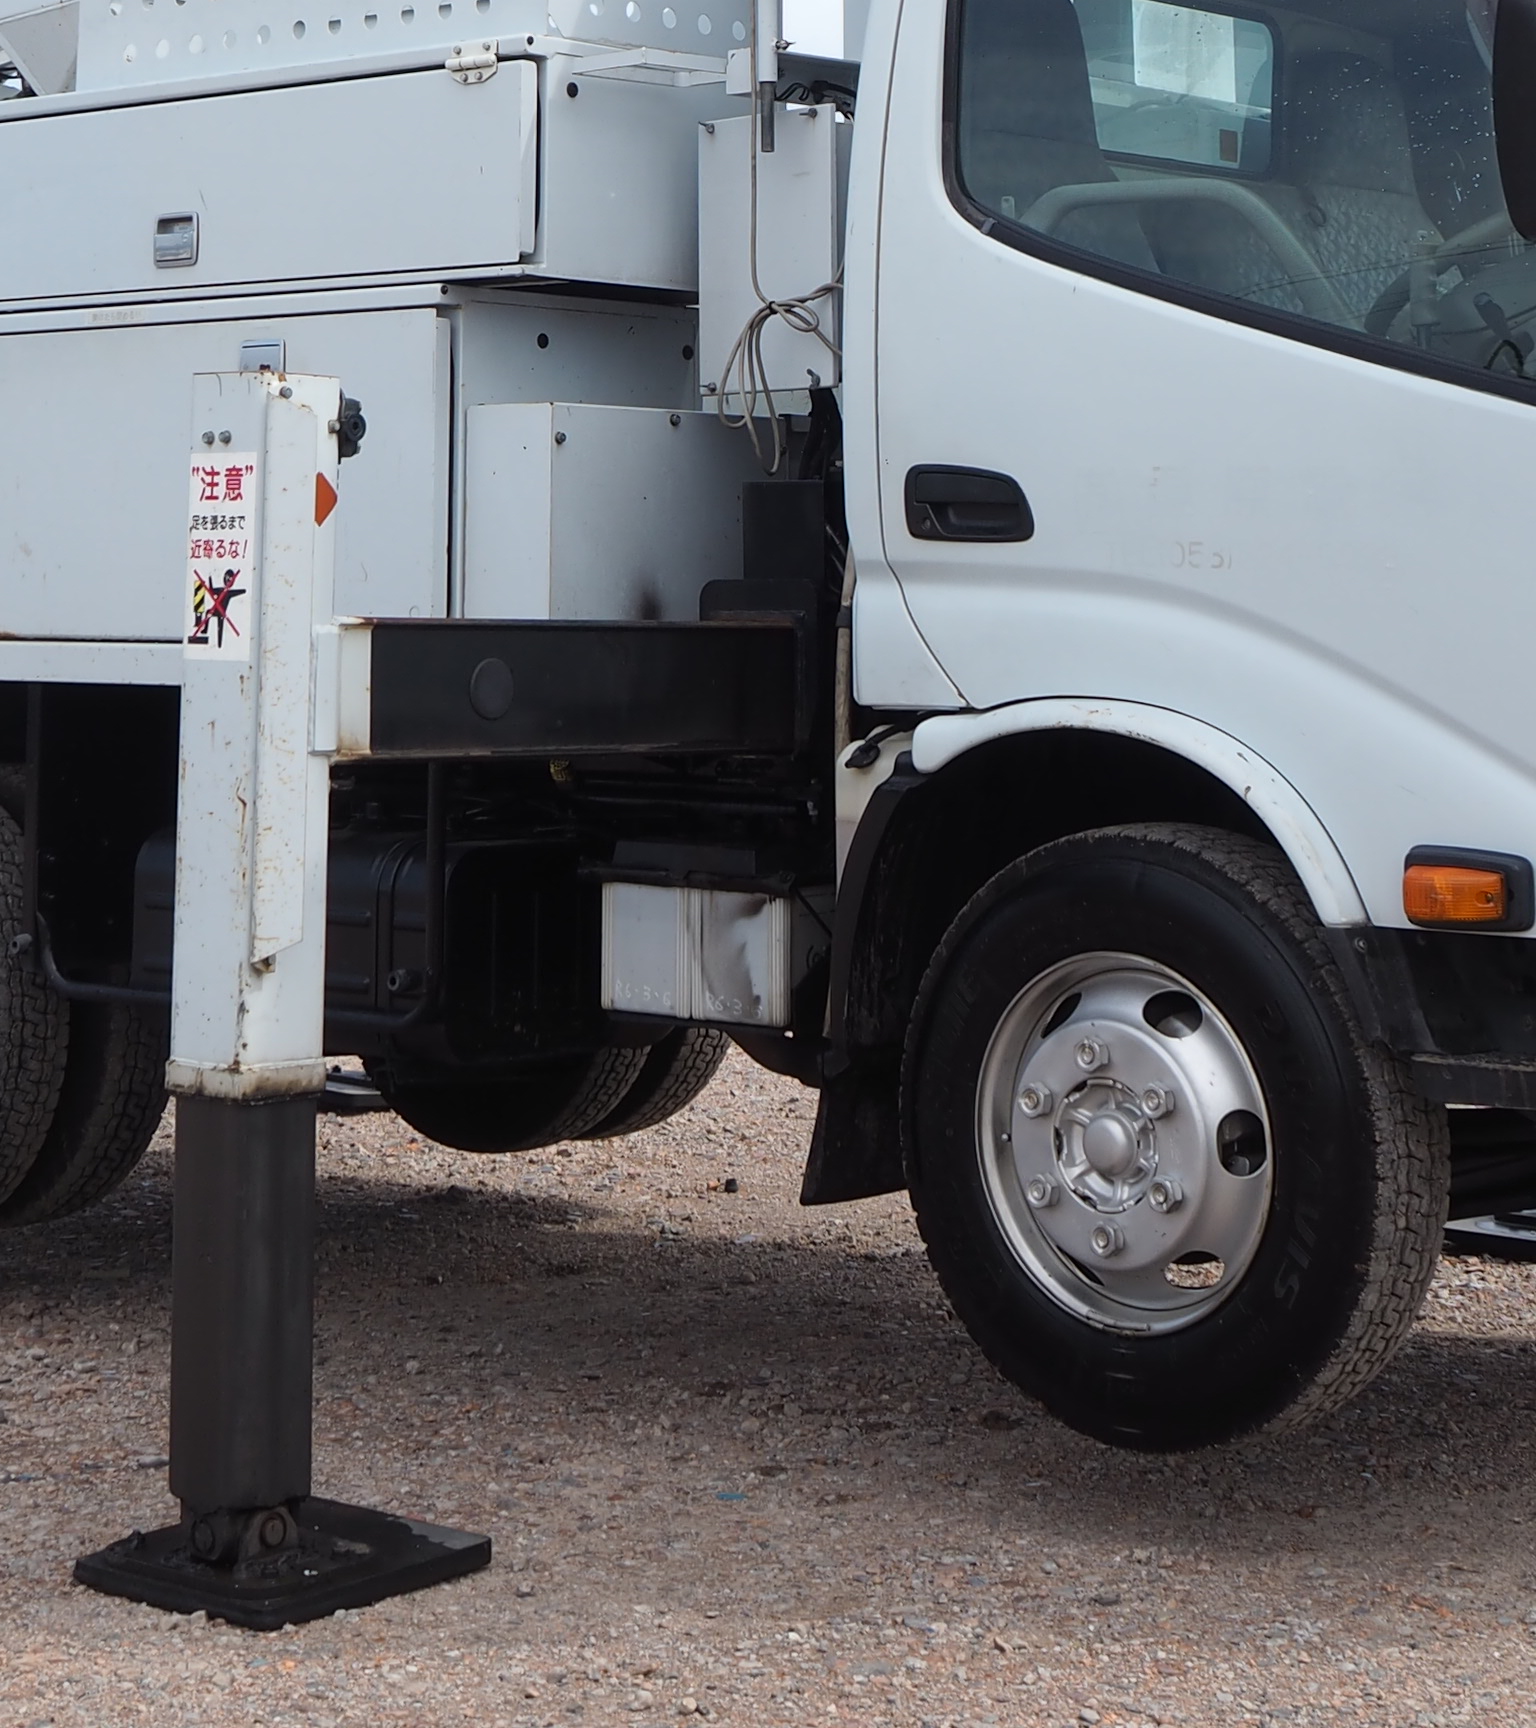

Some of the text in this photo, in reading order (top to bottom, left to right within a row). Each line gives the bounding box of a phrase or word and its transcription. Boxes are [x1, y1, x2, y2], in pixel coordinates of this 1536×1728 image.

[191, 515, 246, 531] 足を張るまで
[190, 539, 248, 560] 近寄るな!
